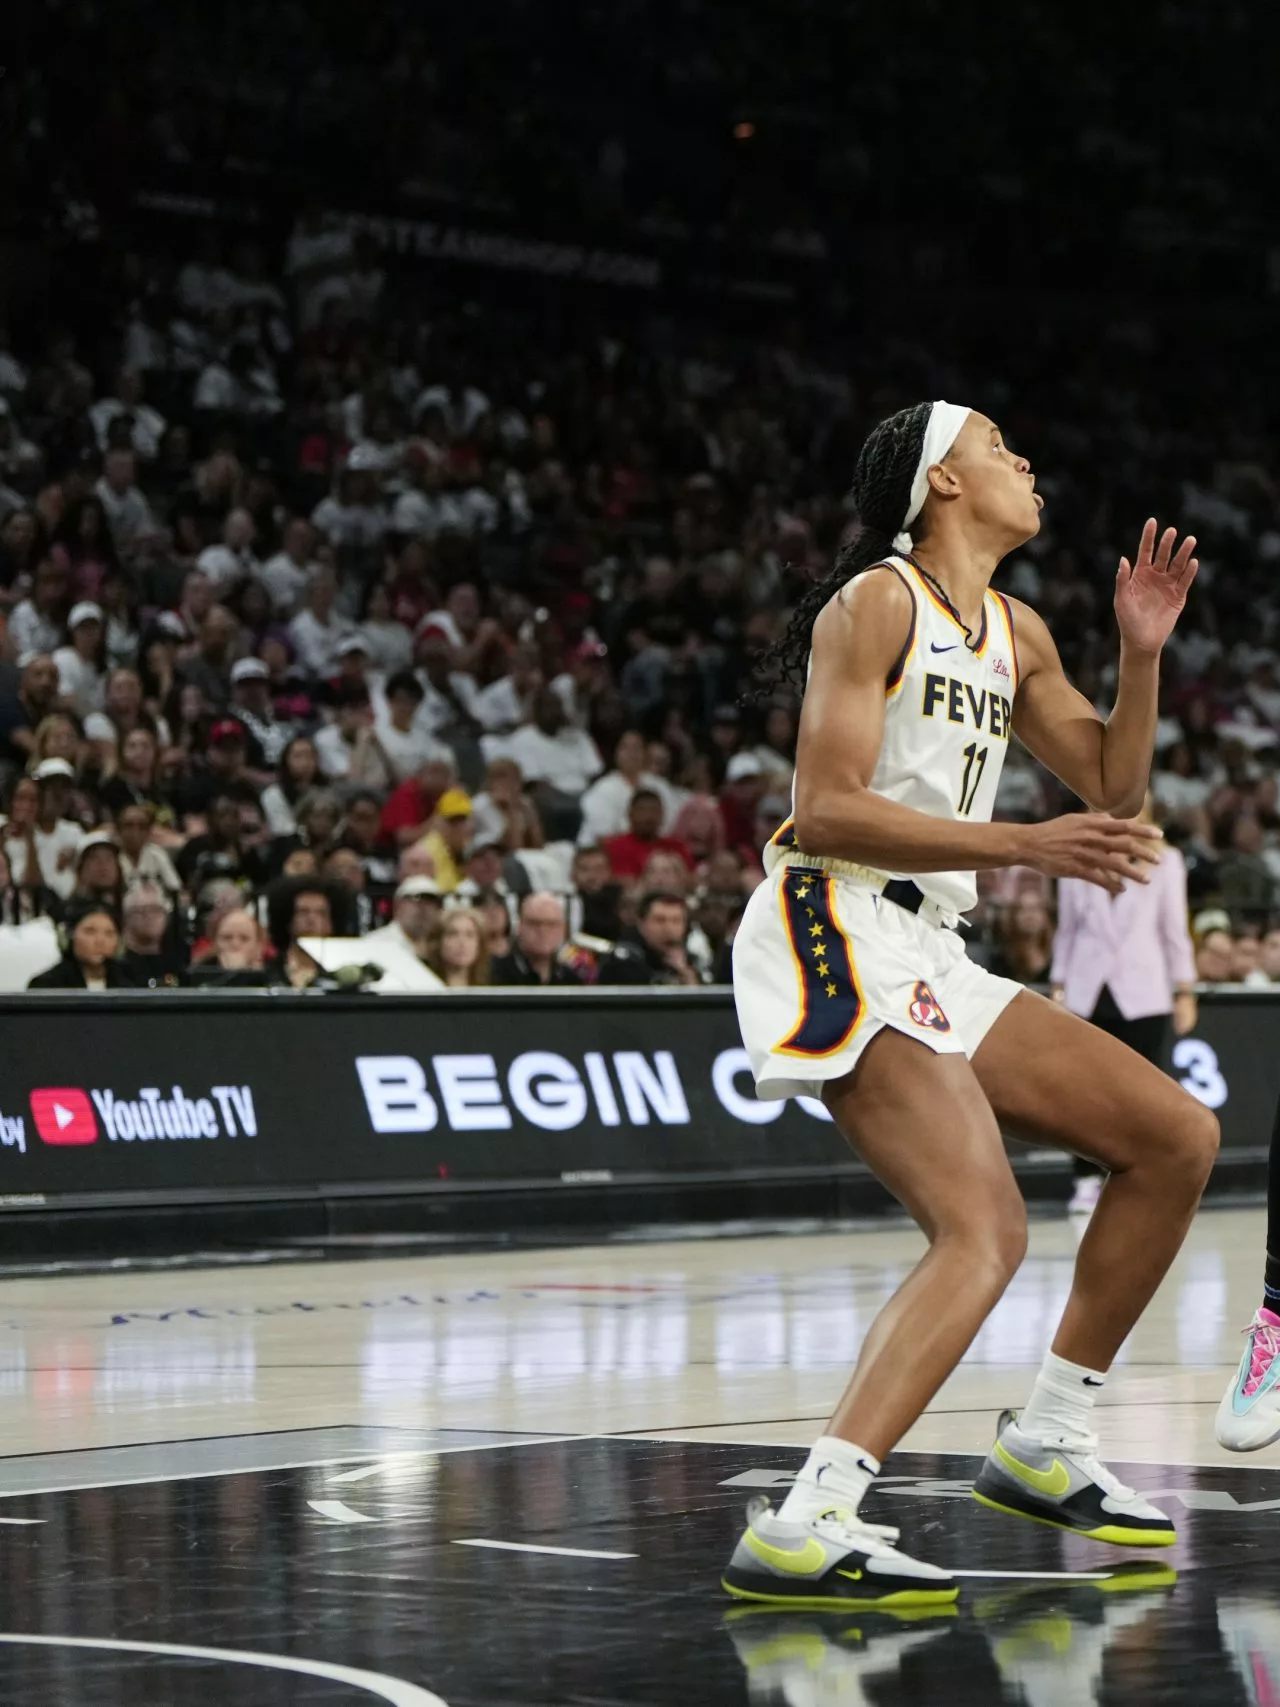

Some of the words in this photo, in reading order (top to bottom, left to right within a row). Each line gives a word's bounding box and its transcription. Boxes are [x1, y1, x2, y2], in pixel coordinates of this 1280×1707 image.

[922, 672, 1011, 742] FEVER
[957, 742, 988, 816] 11
[90, 1085, 219, 1141] YouTube
[210, 1085, 258, 1137] TV
[355, 1049, 691, 1133] BEGIN
